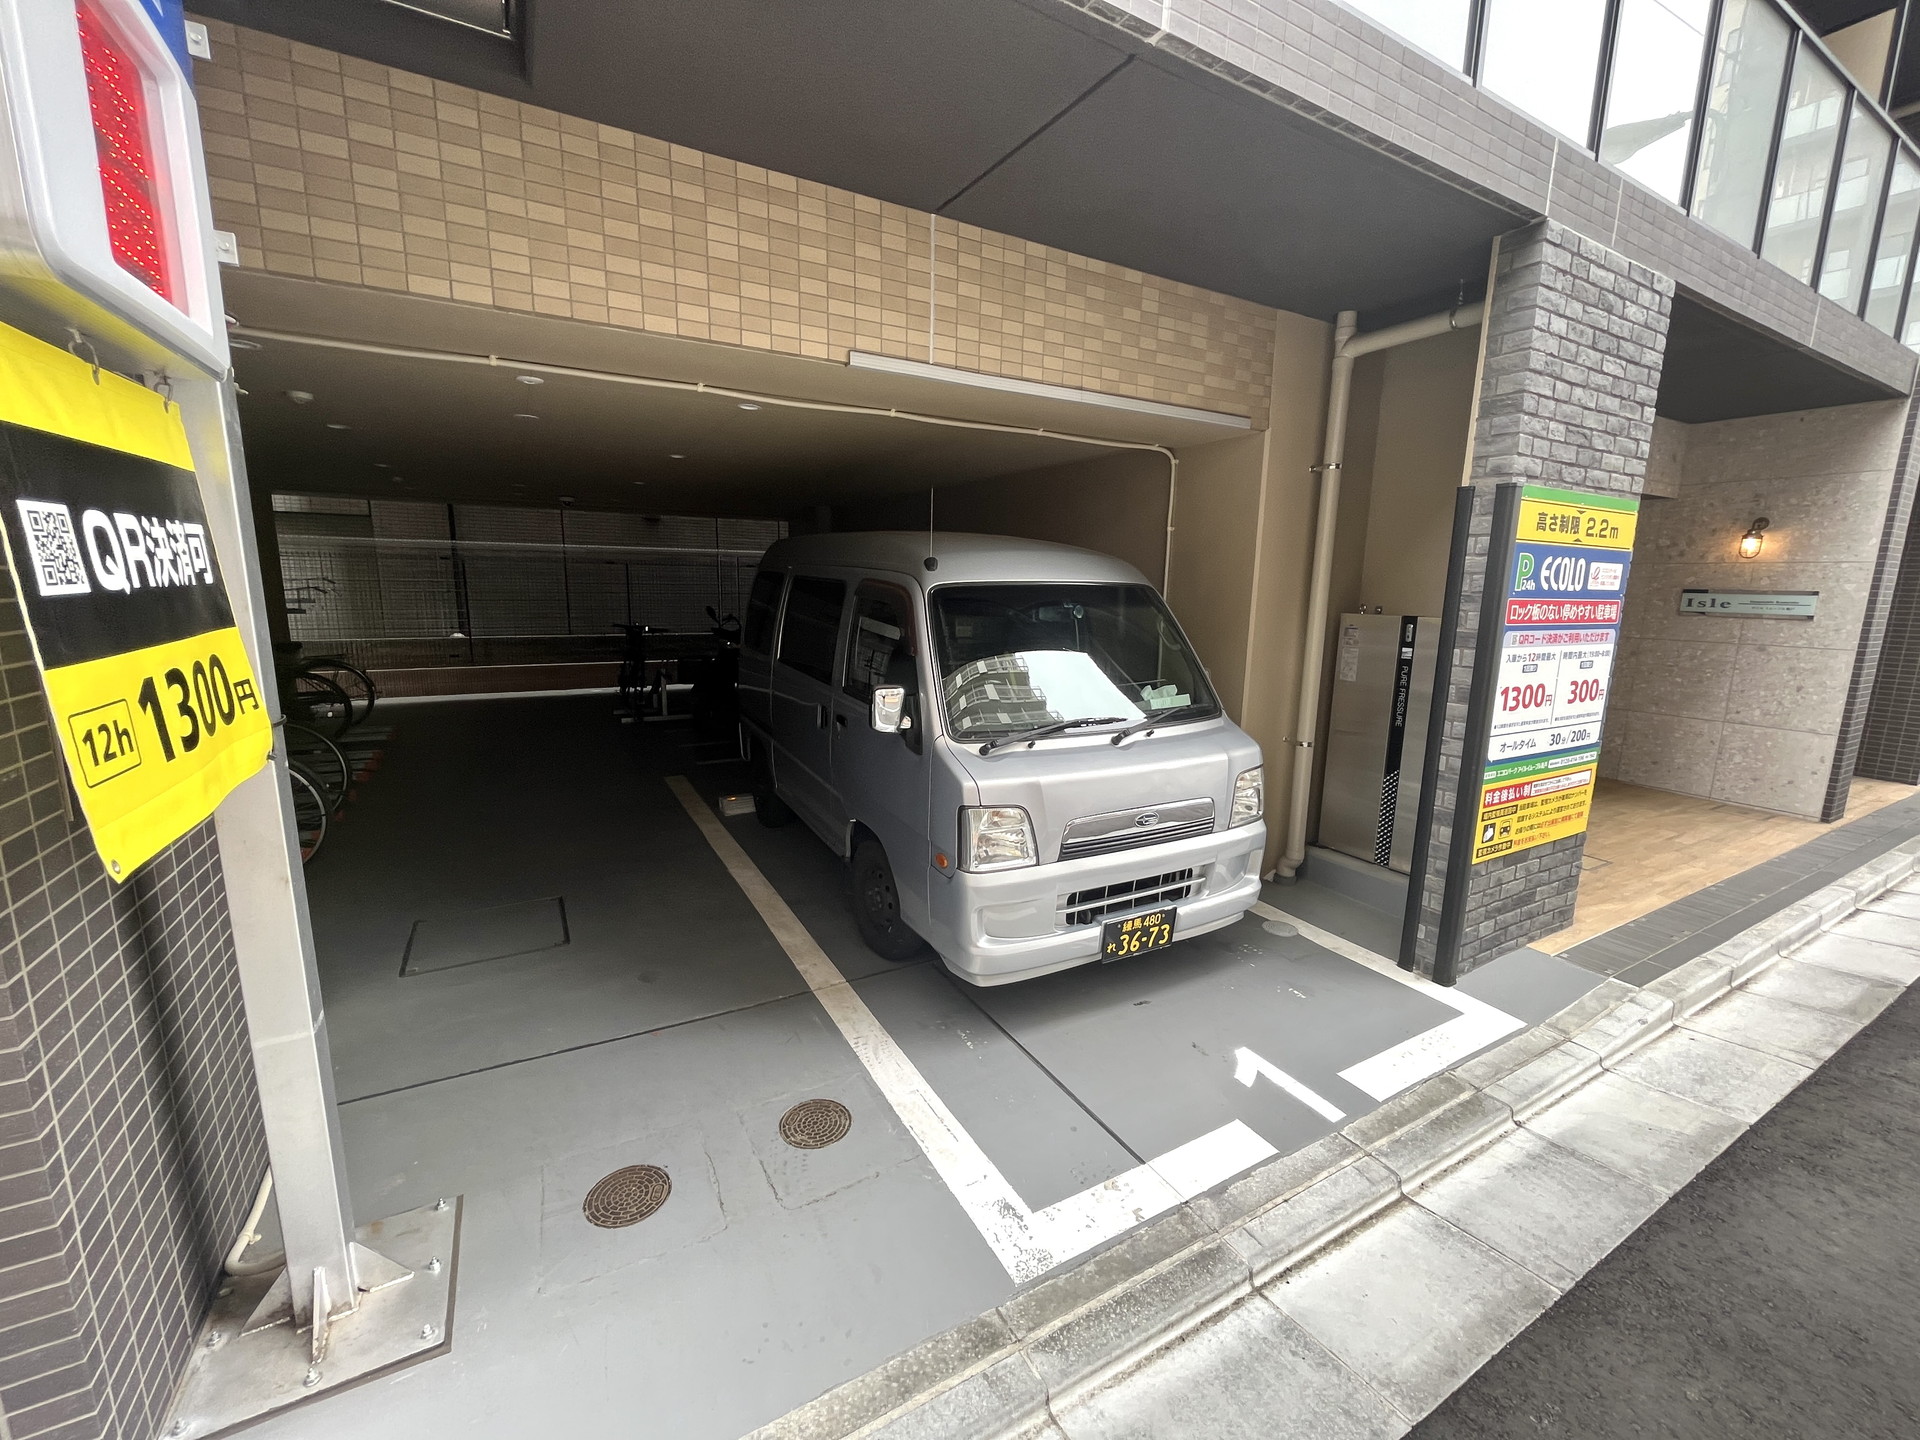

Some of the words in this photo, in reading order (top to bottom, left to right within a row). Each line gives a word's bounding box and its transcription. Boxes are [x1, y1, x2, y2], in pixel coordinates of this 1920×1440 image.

[1536, 511, 1581, 534] 高さ制限
[1585, 517, 1619, 539] 2.2m
[82, 509, 214, 594] QR決済可
[1522, 579, 1536, 591] 24h
[1540, 556, 1586, 592] ECOLO
[1510, 603, 1618, 621] ロック板のない停めやすい駐車場
[1686, 598, 1732, 608] Isle
[1500, 683, 1553, 711] 1300円
[1567, 678, 1605, 704] 300円
[81, 719, 135, 768] 12h
[138, 653, 260, 764] 1300円
[1499, 738, 1537, 753] オールタイム
[1484, 783, 1532, 806] 料金後払い制
[1122, 918, 1142, 932] 練馬
[1143, 913, 1161, 927] 480
[1117, 923, 1170, 955] 36-73
[1234, 1046, 1347, 1123] 1
